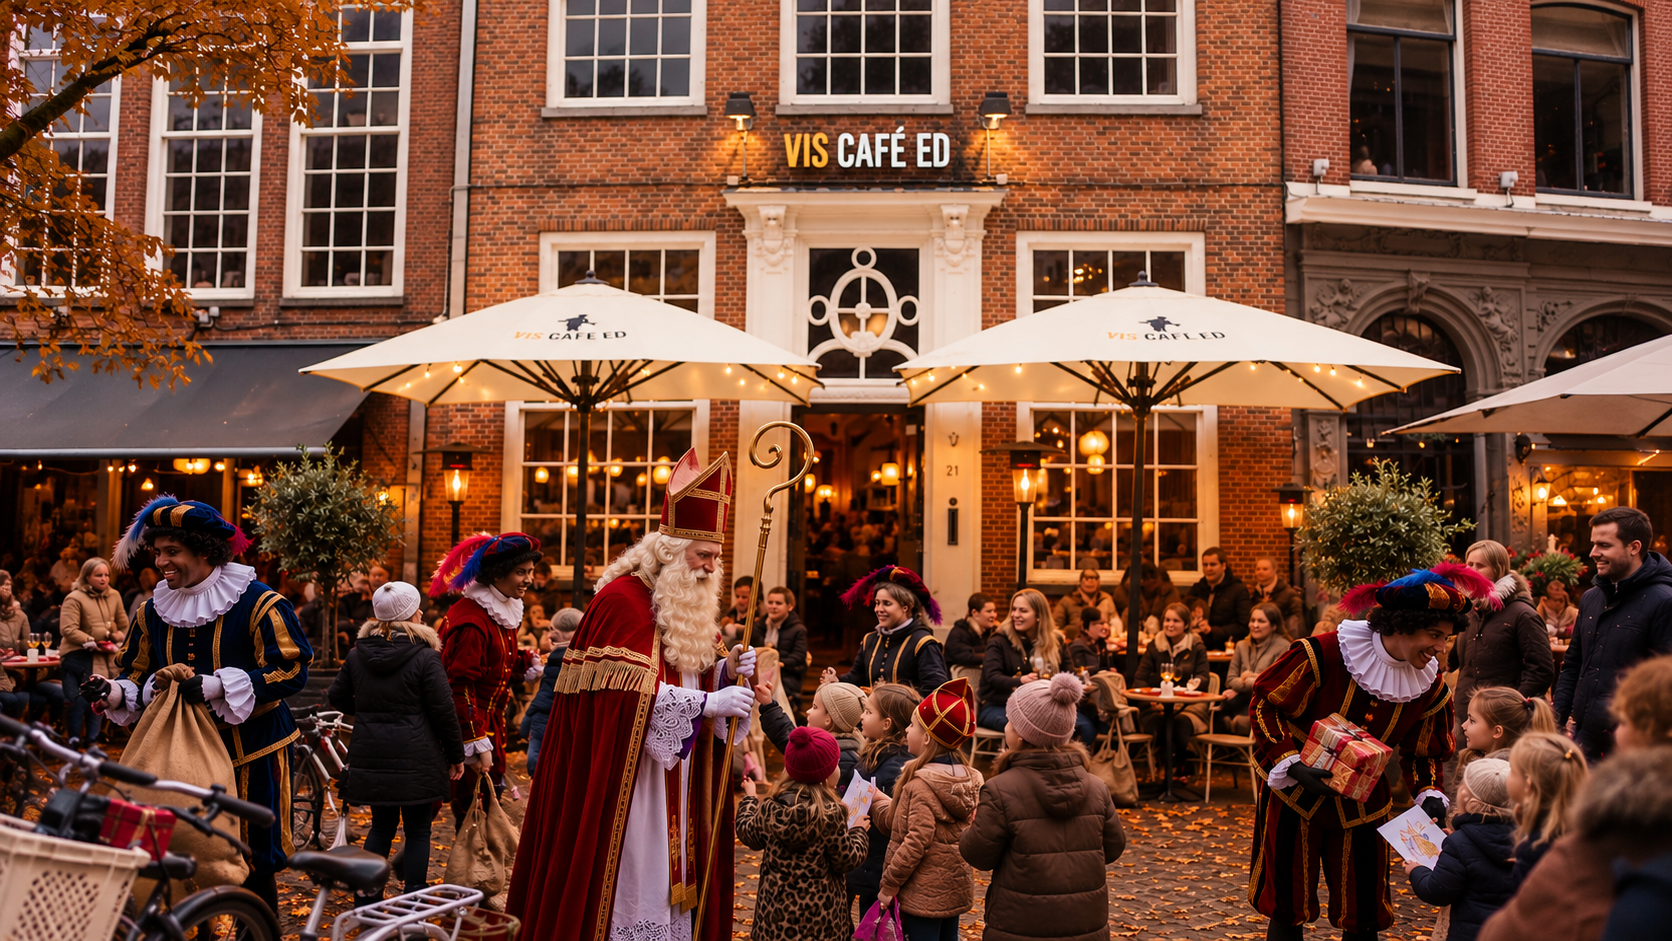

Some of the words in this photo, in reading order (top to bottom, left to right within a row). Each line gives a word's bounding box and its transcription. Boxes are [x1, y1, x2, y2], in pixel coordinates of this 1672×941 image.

[784, 132, 829, 168] VIS
[837, 126, 907, 168] CAFÉ
[916, 132, 950, 168] ED
[514, 331, 544, 340] VIS
[548, 332, 596, 341] CAFE
[602, 331, 627, 339] ED
[1107, 332, 1138, 340] VIS
[1199, 331, 1226, 340] ED
[946, 465, 959, 476] 21
